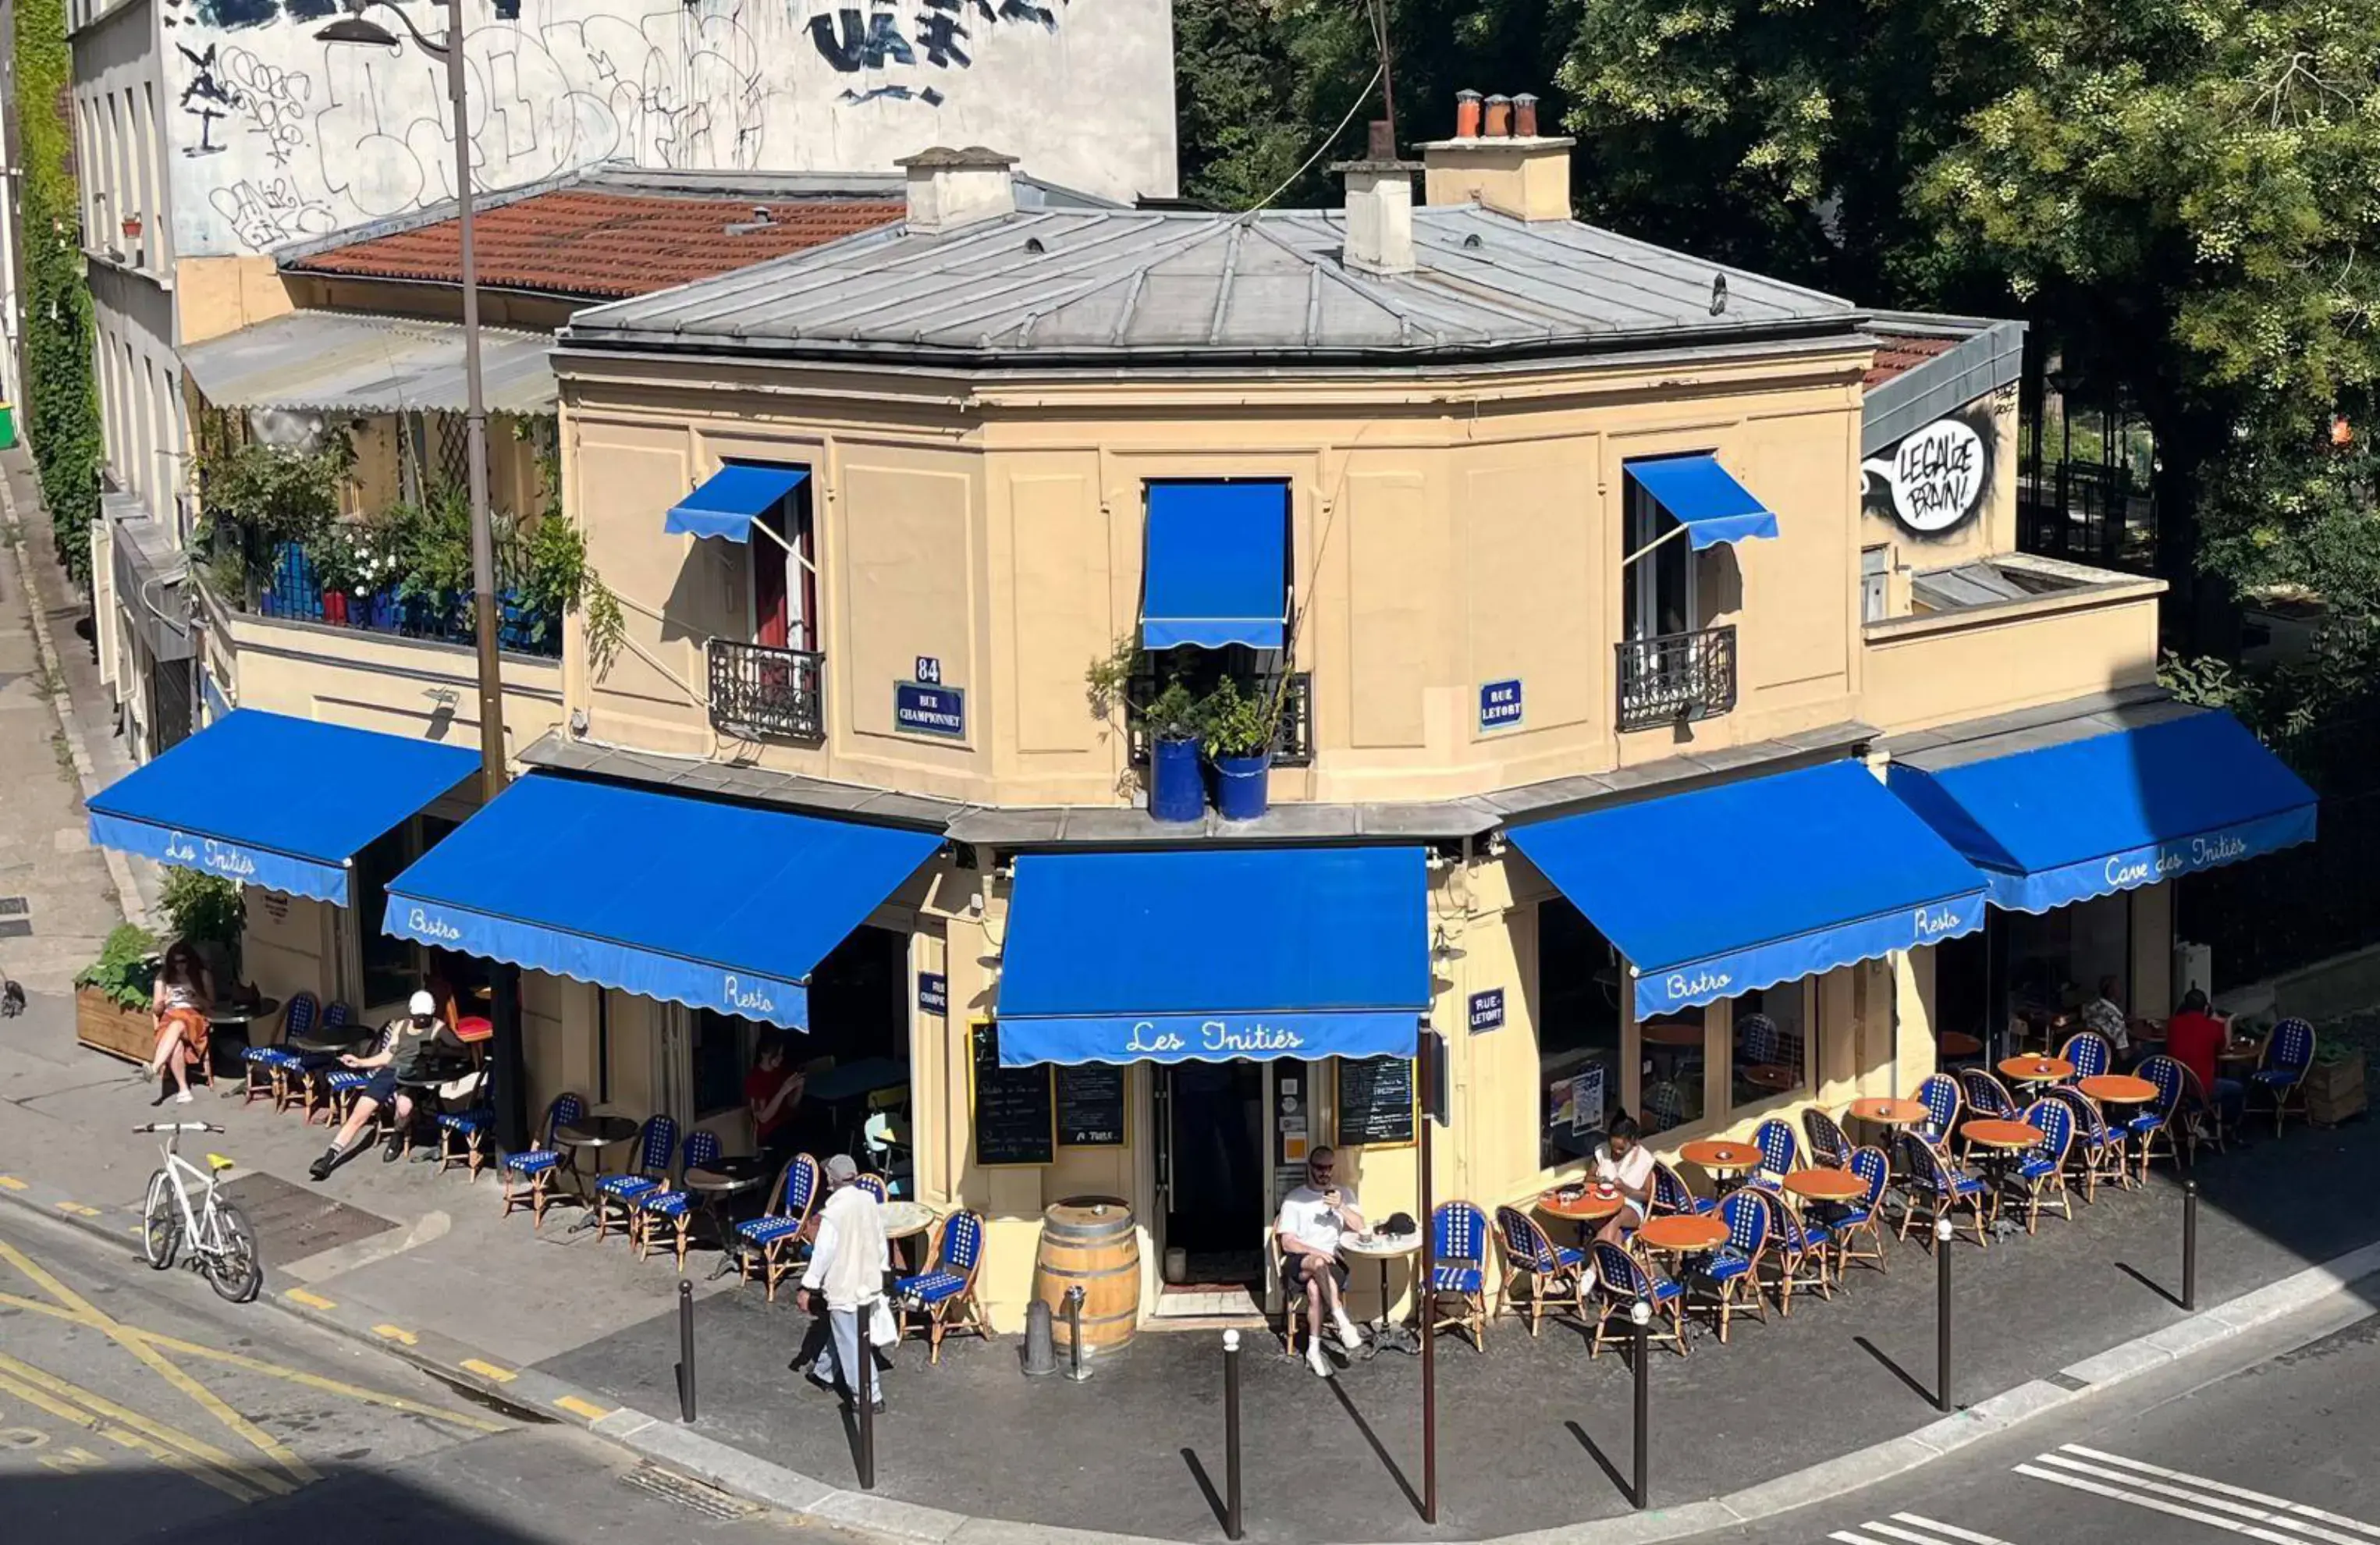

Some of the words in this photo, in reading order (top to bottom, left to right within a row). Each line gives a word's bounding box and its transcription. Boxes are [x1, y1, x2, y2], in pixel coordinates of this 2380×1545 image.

[918, 658, 939, 681] 84
[919, 695, 938, 709] RUE
[1490, 688, 1513, 702] RUE
[899, 708, 961, 727] CHAMPIONNET
[1483, 702, 1521, 720] LETORT
[165, 830, 196, 861] Les
[2105, 856, 2148, 886] Cave
[2154, 846, 2183, 873] des
[408, 907, 461, 939] Bistro
[1914, 908, 1960, 937] Resto
[723, 975, 774, 1012] Resto
[1667, 974, 1732, 1000] Bistro
[1475, 996, 1497, 1010] RUE
[1471, 1008, 1501, 1025] LETORT
[1126, 1021, 1185, 1052] Les
[1202, 1021, 1305, 1051] Initiés
